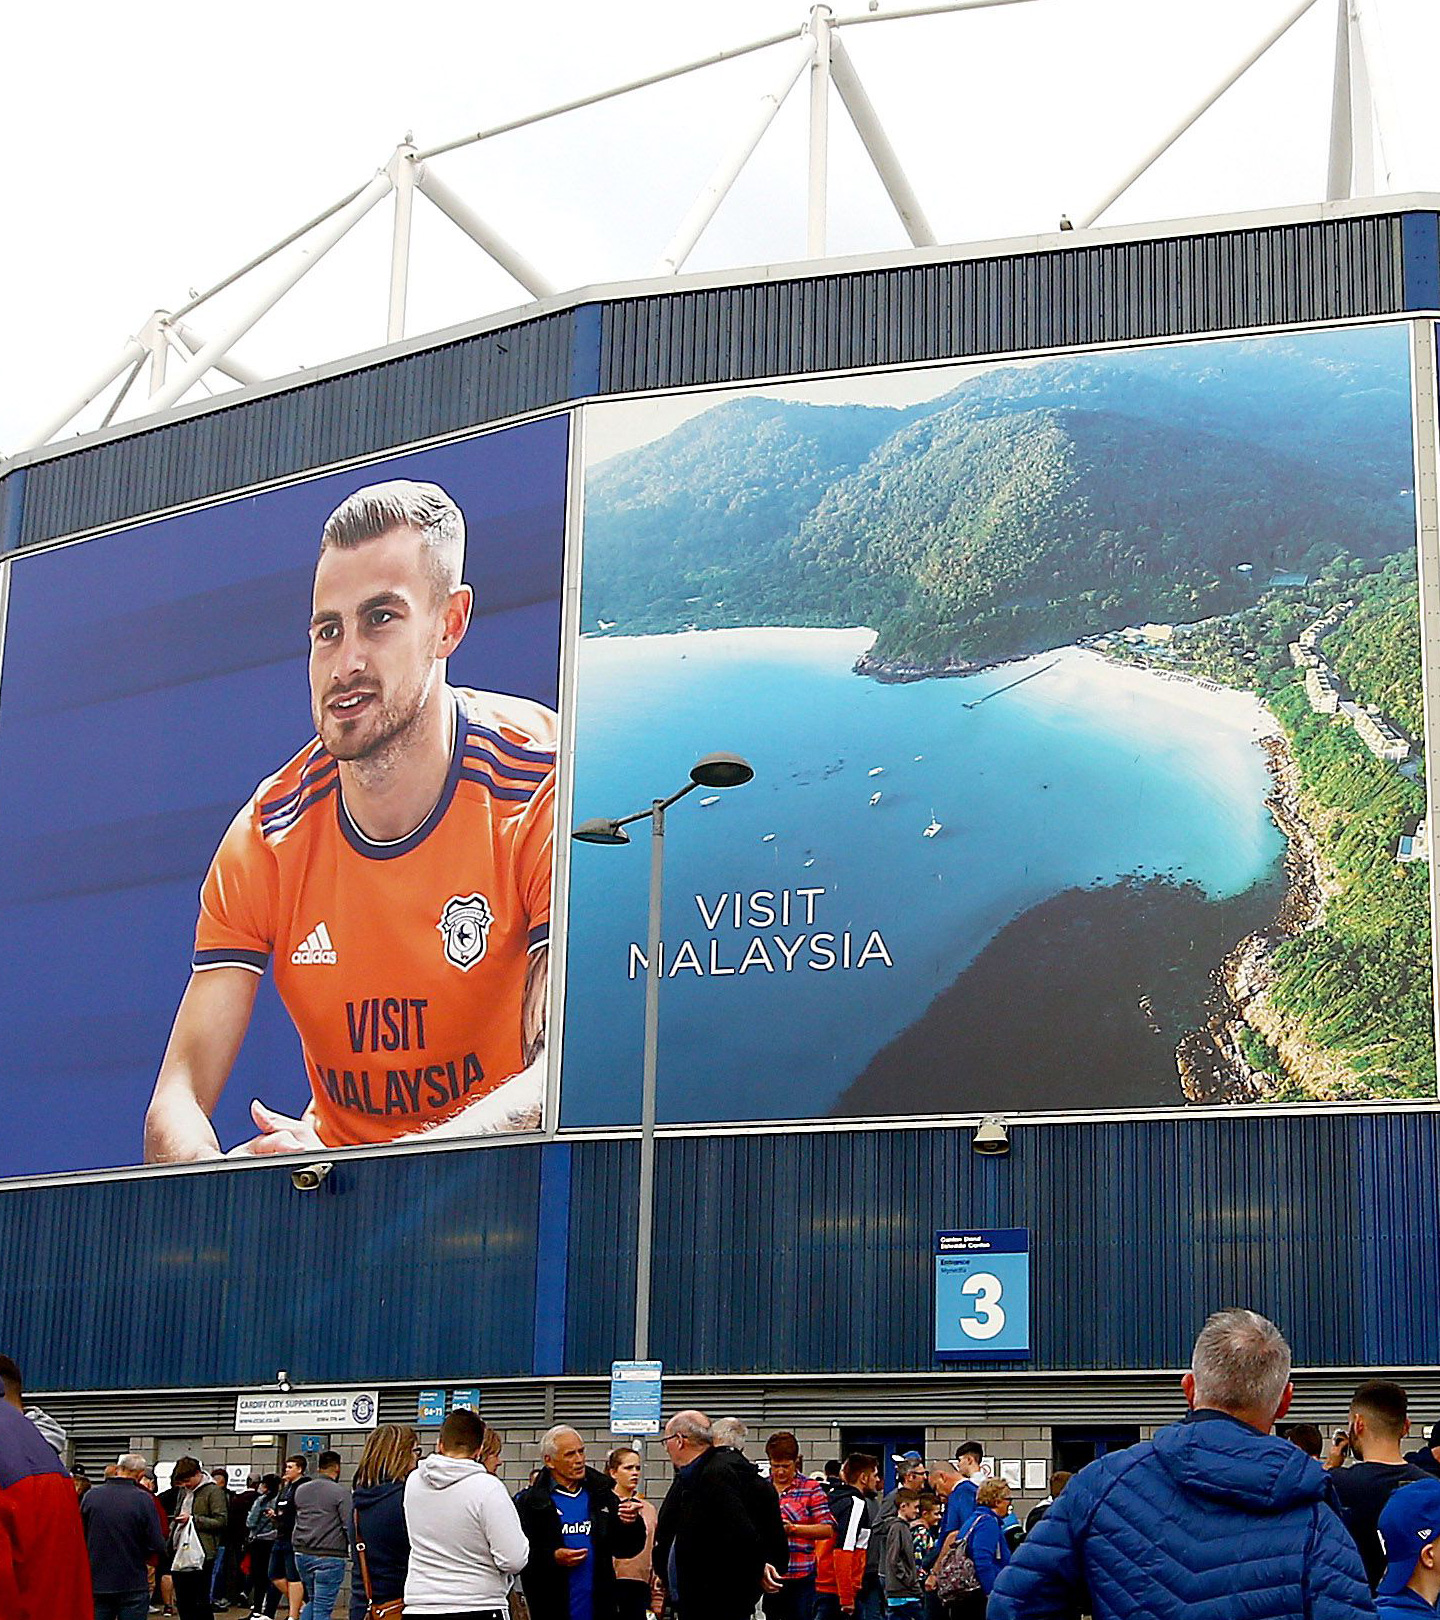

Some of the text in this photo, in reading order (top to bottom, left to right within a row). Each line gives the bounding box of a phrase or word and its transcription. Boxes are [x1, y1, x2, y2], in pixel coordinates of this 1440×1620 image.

[695, 887, 826, 930] VISIT
[291, 950, 338, 965] adidas
[628, 930, 894, 979] MALAYSIA
[346, 996, 428, 1054] VISIT
[317, 1052, 486, 1115] MALAYSIA
[959, 1272, 1007, 1341] 3
[240, 1398, 347, 1409] CARDIFF CITY SUPPORTERS CLUB
